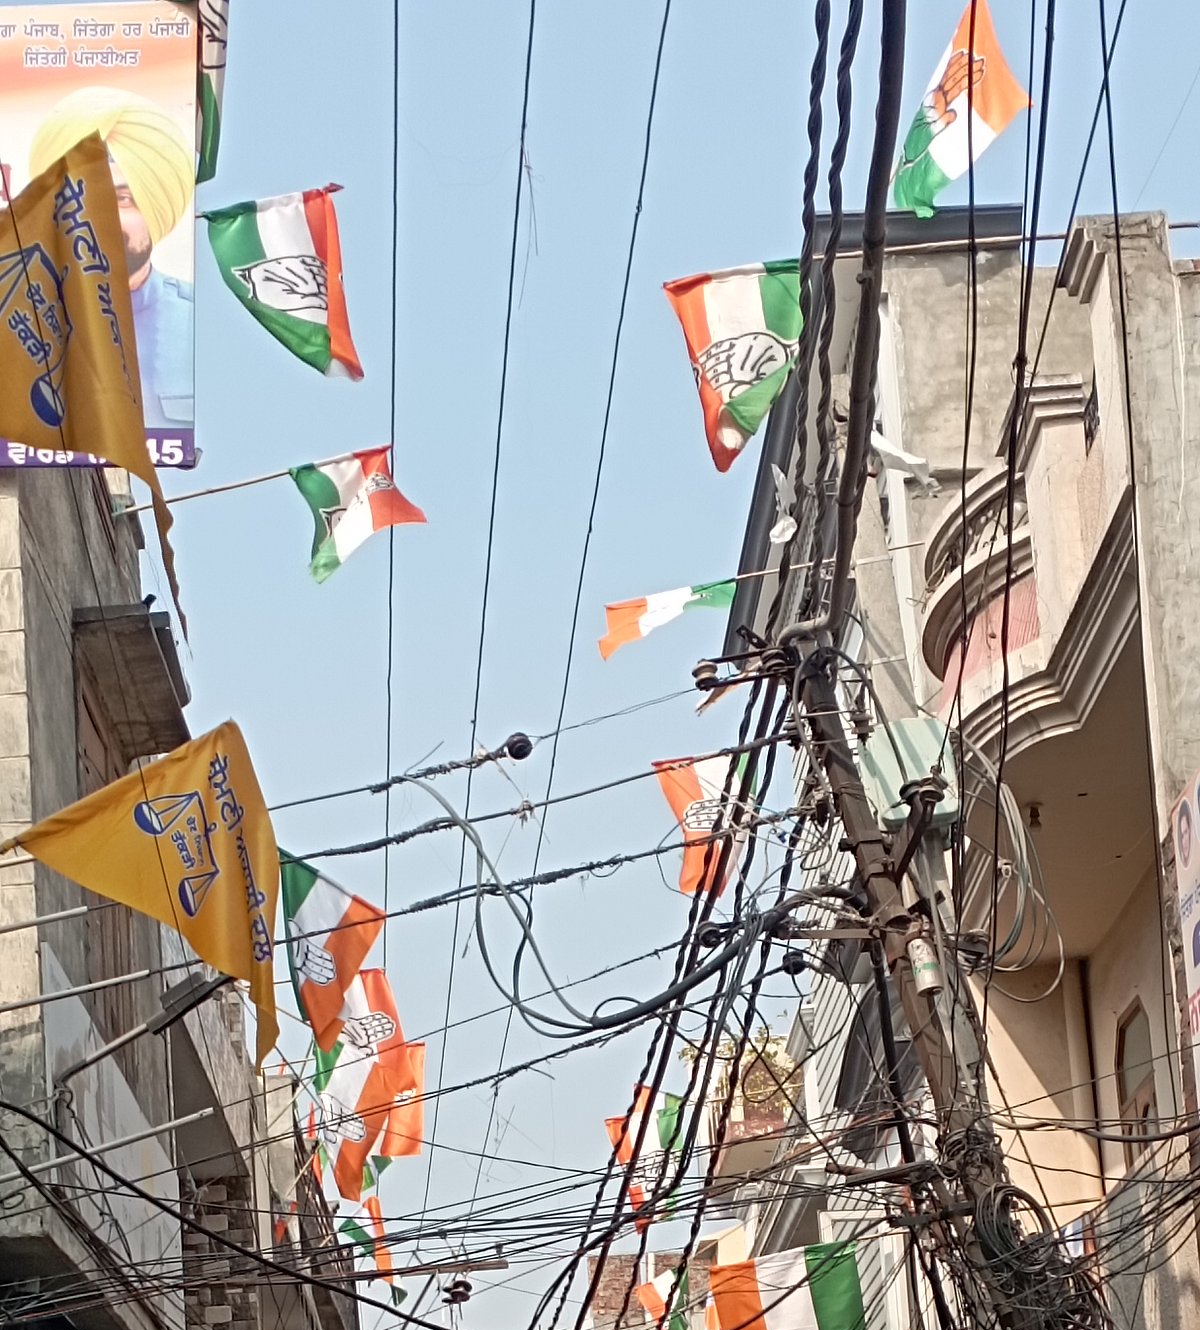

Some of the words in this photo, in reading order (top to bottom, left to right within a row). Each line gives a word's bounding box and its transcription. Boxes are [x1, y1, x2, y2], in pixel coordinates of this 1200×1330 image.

[24, 18, 65, 39] ਪੰਜਾਬ,
[73, 17, 115, 37] ਜਿੱਤੇਗਾ
[123, 23, 142, 37] ਹਰ
[149, 17, 190, 36] ਪੰਜਾਬੀ
[25, 47, 67, 65] ਜਿੱਤੇਗੀ
[74, 46, 139, 65] ਪੰਜਾਬੀਅਤ
